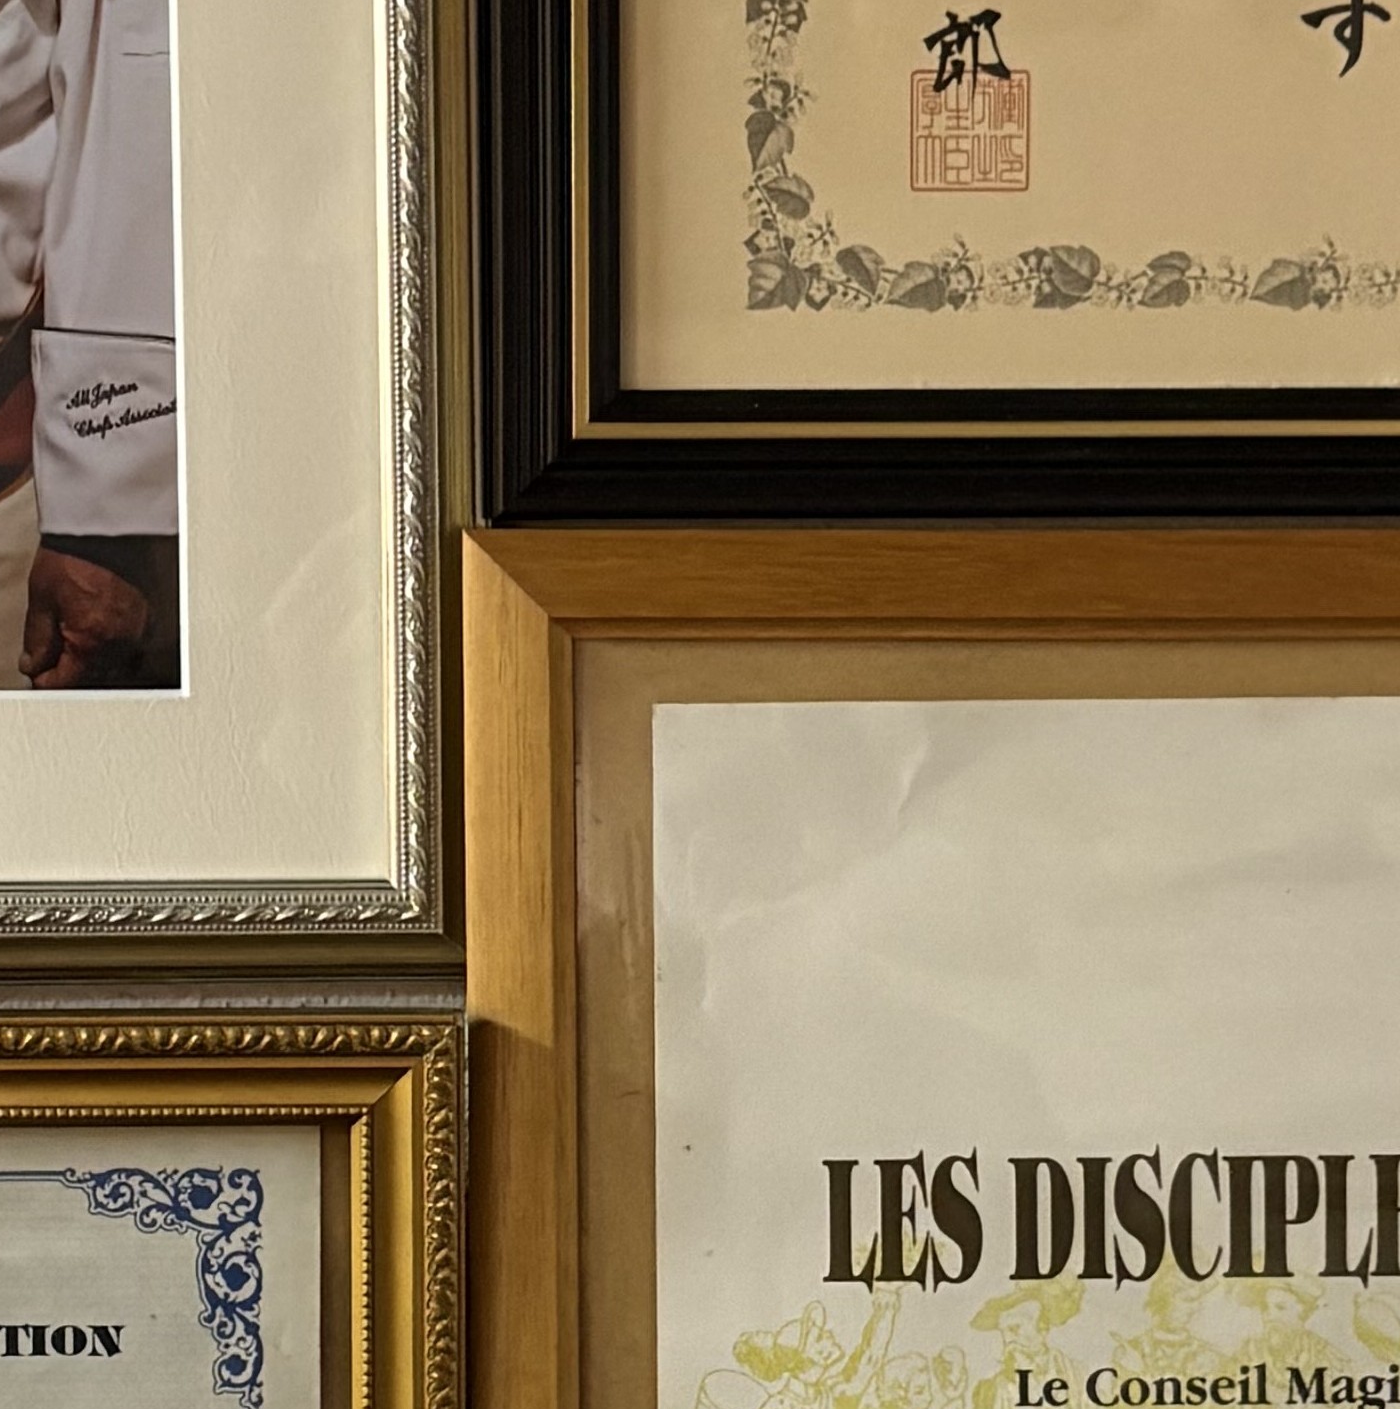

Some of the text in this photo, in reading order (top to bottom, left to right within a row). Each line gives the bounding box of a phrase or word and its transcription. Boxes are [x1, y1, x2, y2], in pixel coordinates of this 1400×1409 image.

[66, 382, 139, 410] All Japan
[73, 414, 114, 440] Chefs
[821, 1146, 985, 1295] LES
[1015, 1368, 1070, 1409] Le
[1085, 1363, 1271, 1407] Conseil
